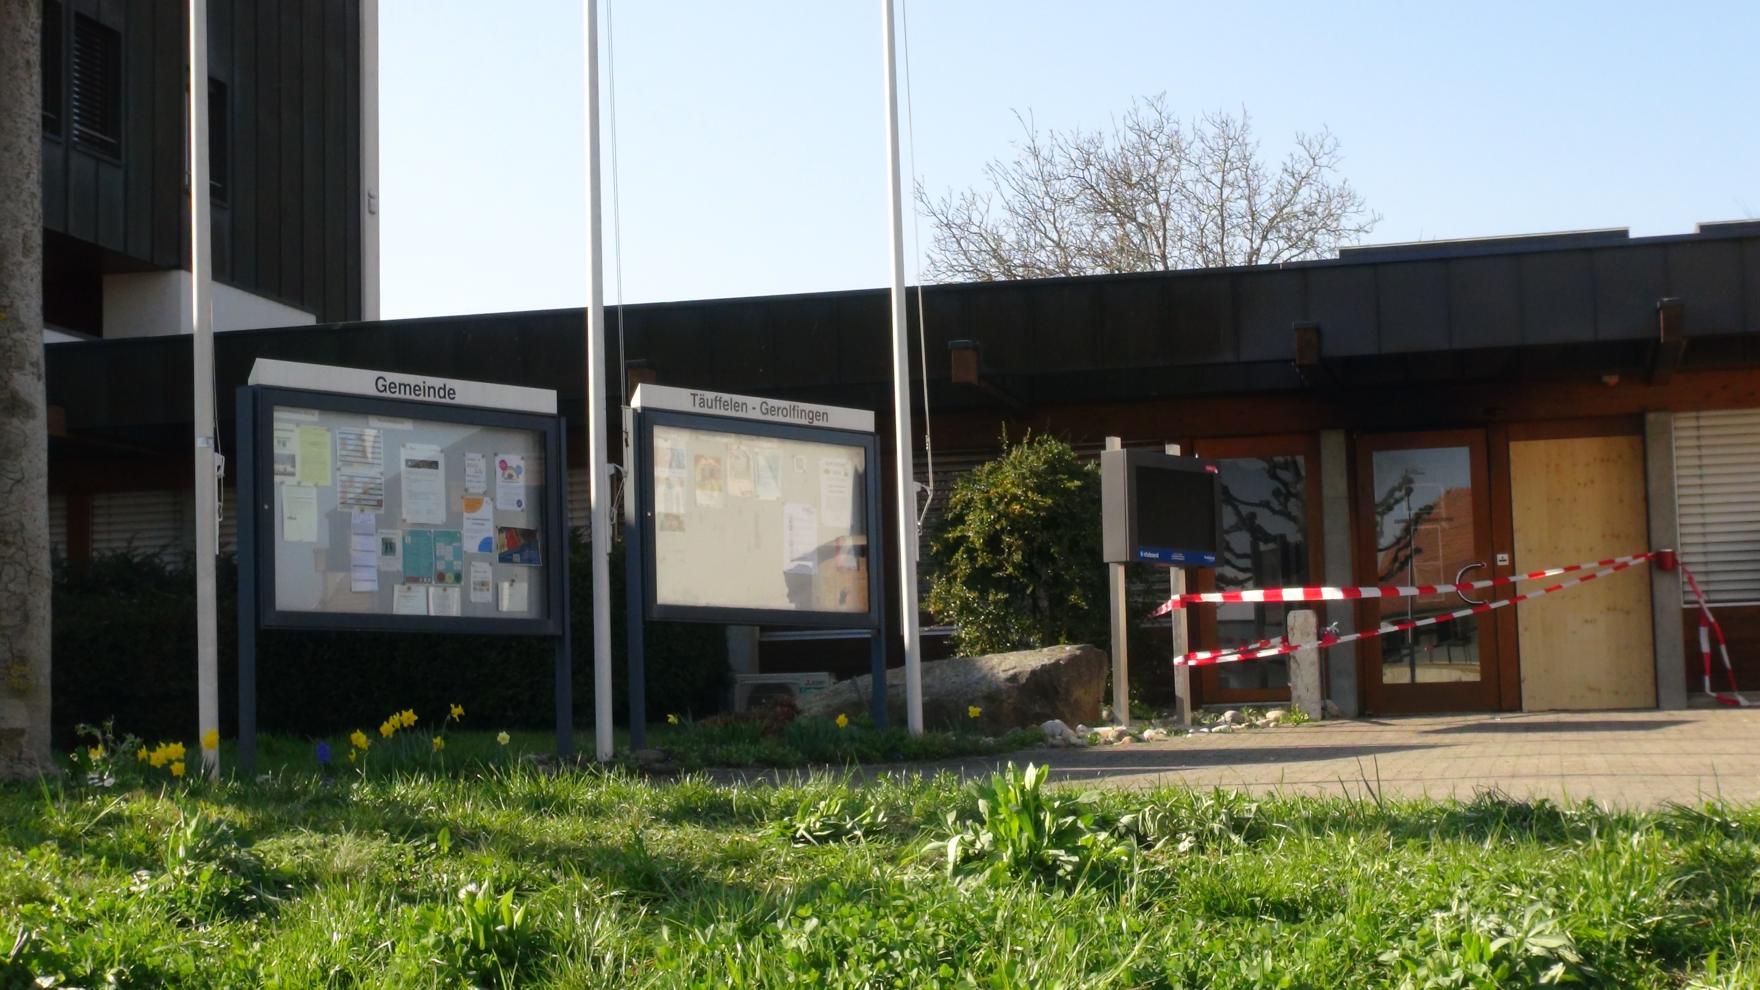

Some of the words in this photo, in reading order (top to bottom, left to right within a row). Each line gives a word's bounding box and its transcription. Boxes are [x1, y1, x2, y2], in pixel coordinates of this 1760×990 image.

[375, 376, 456, 400] Gemeinde
[690, 392, 748, 413] Täuffelen
[759, 401, 830, 425] Gerolfingen
